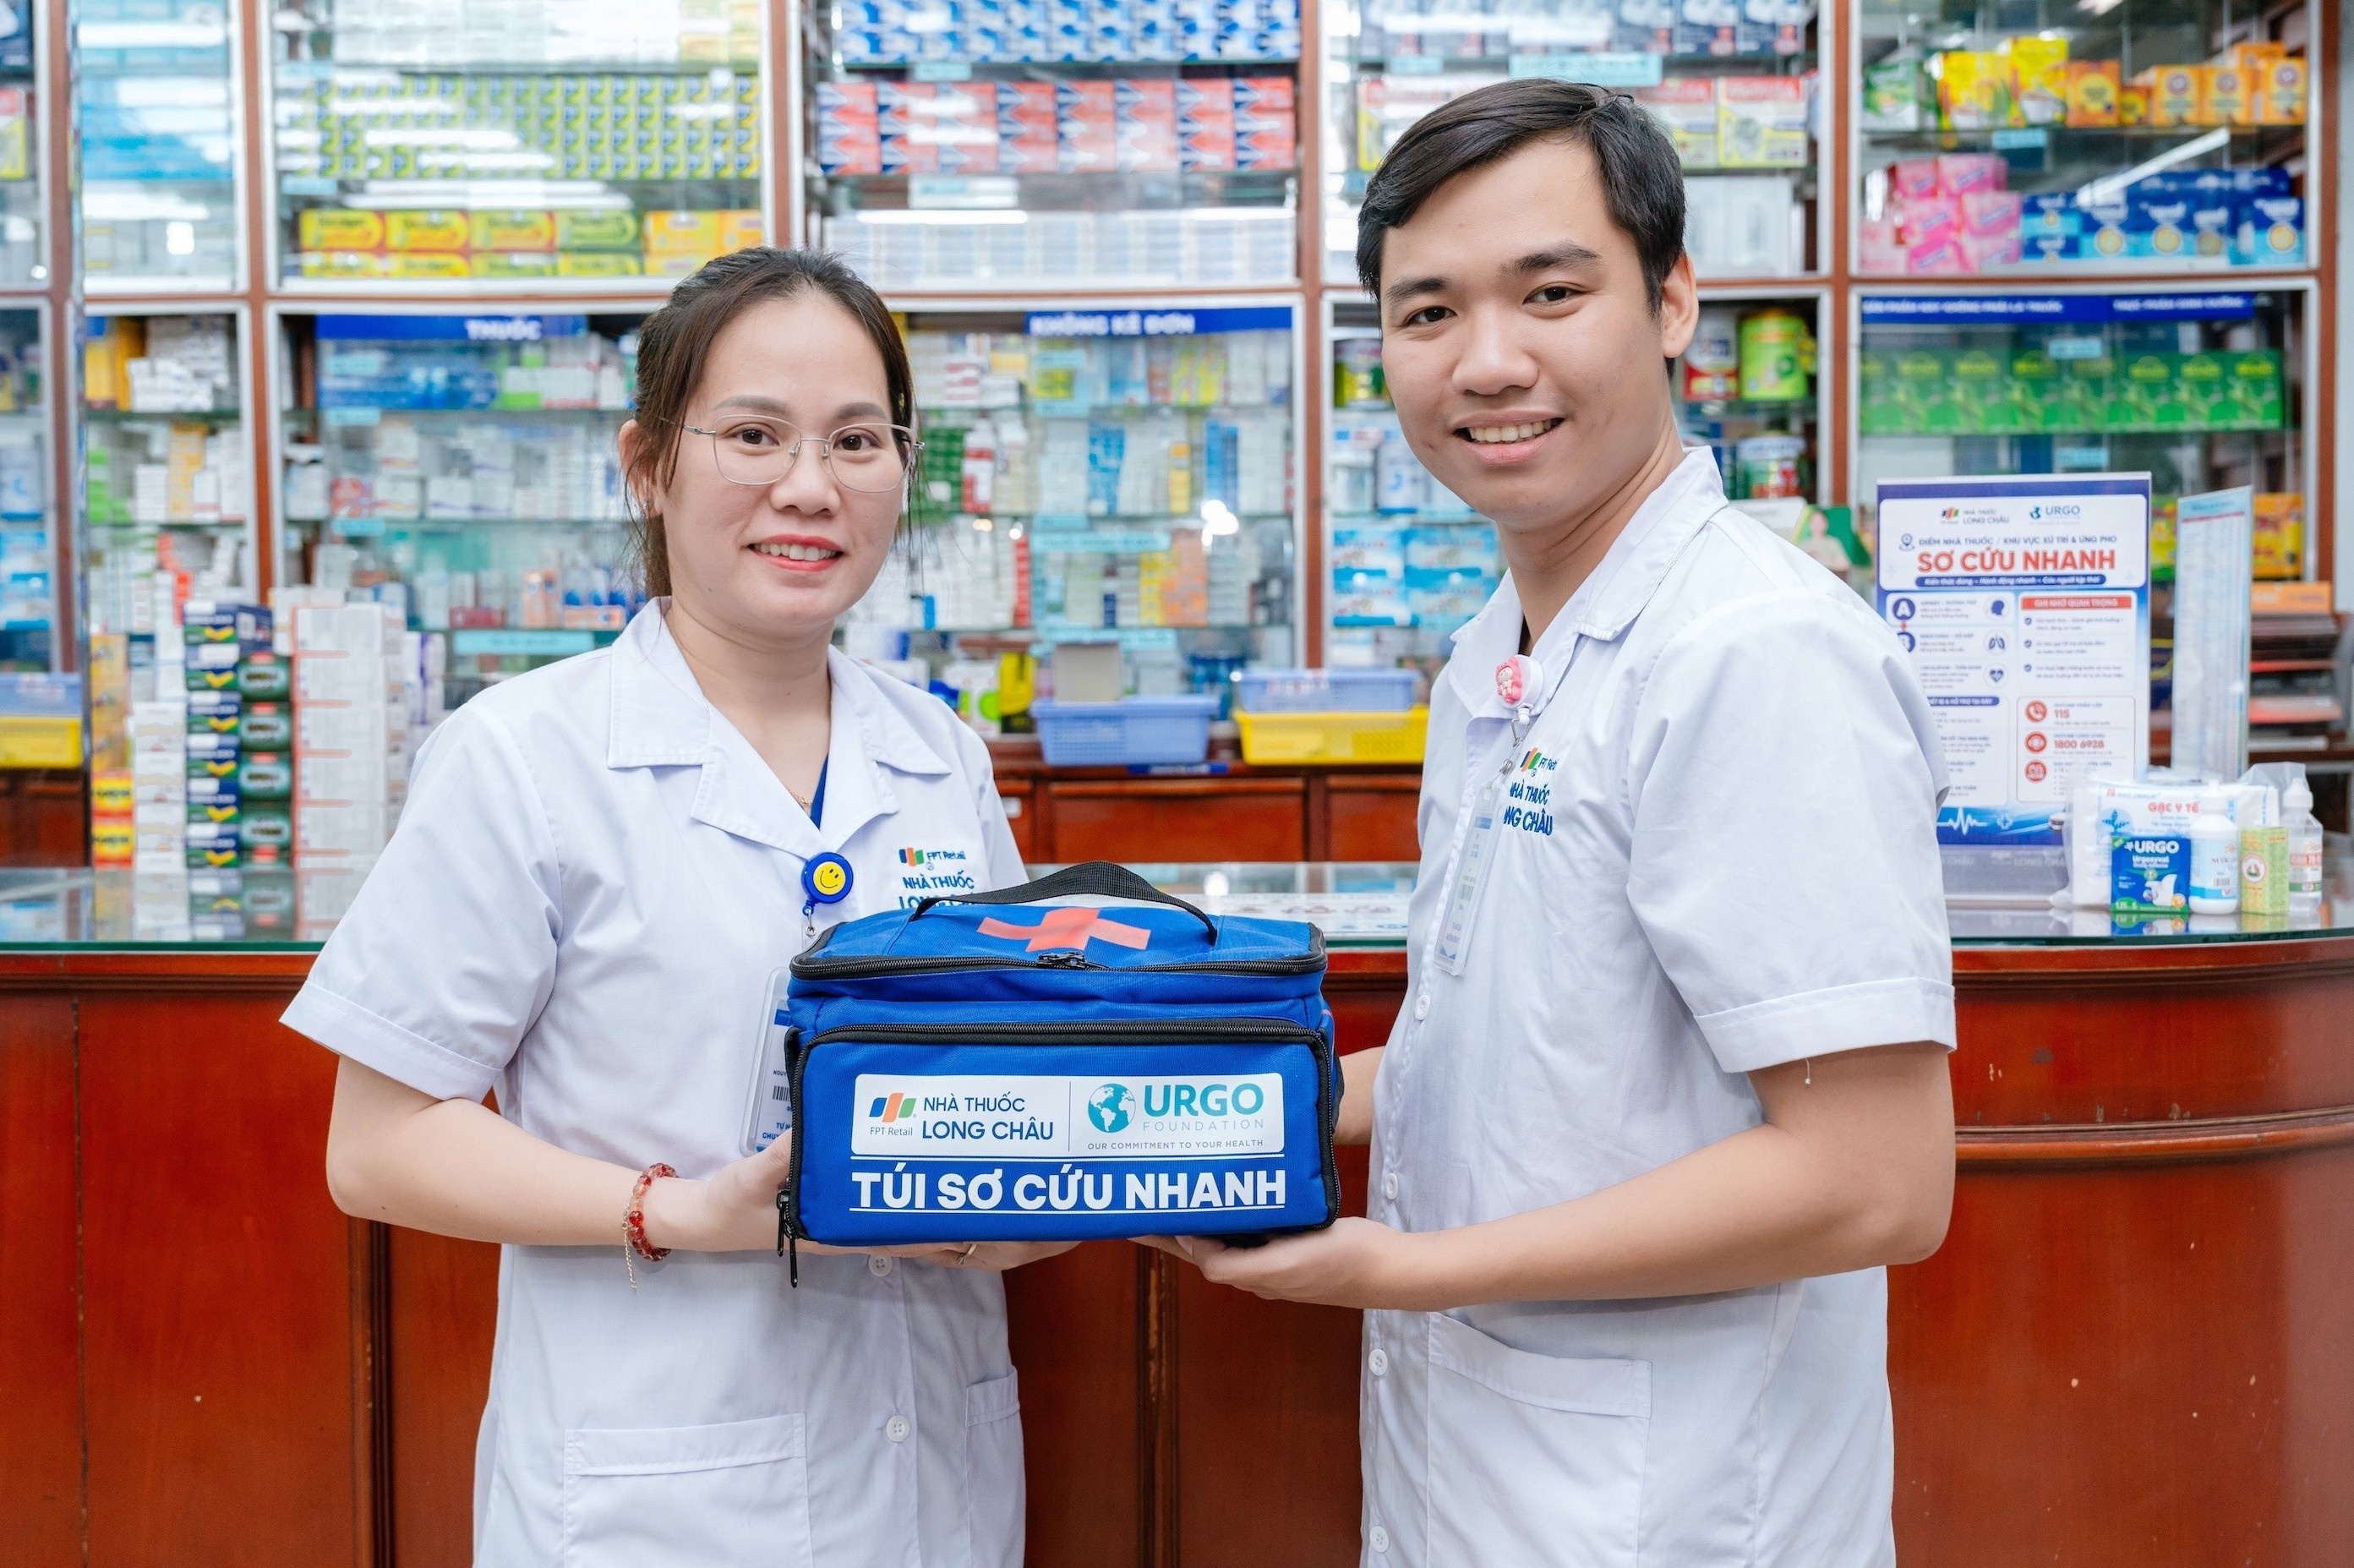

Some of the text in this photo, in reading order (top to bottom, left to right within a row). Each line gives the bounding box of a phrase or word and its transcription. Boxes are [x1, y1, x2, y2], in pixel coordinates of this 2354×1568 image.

[464, 315, 541, 340] THUỐC
[2045, 505, 2080, 516] URGO
[1918, 546, 2116, 572] SƠ CỨU NHANH
[2054, 740, 2078, 749] 1800
[1525, 783, 1550, 806] THUỐC
[1522, 808, 1553, 836] CHÂU
[926, 851, 942, 860] FPT
[2134, 840, 2180, 854] URGO
[903, 870, 975, 890] NHÀ THUỐC
[923, 1091, 1025, 1112] NHÀ THUỐC
[1144, 1083, 1264, 1117] URGO
[870, 1127, 913, 1136] FPT Retail
[922, 1116, 1054, 1140] LONG CHÂU
[1144, 1119, 1264, 1132] FOUNDATION
[1111, 1141, 1177, 1150] COMMITMENT
[1193, 1140, 1224, 1149] YOUR
[1226, 1139, 1264, 1148] HEALTH
[851, 1162, 1286, 1210] TÚI SƠ CỨU NHANH
